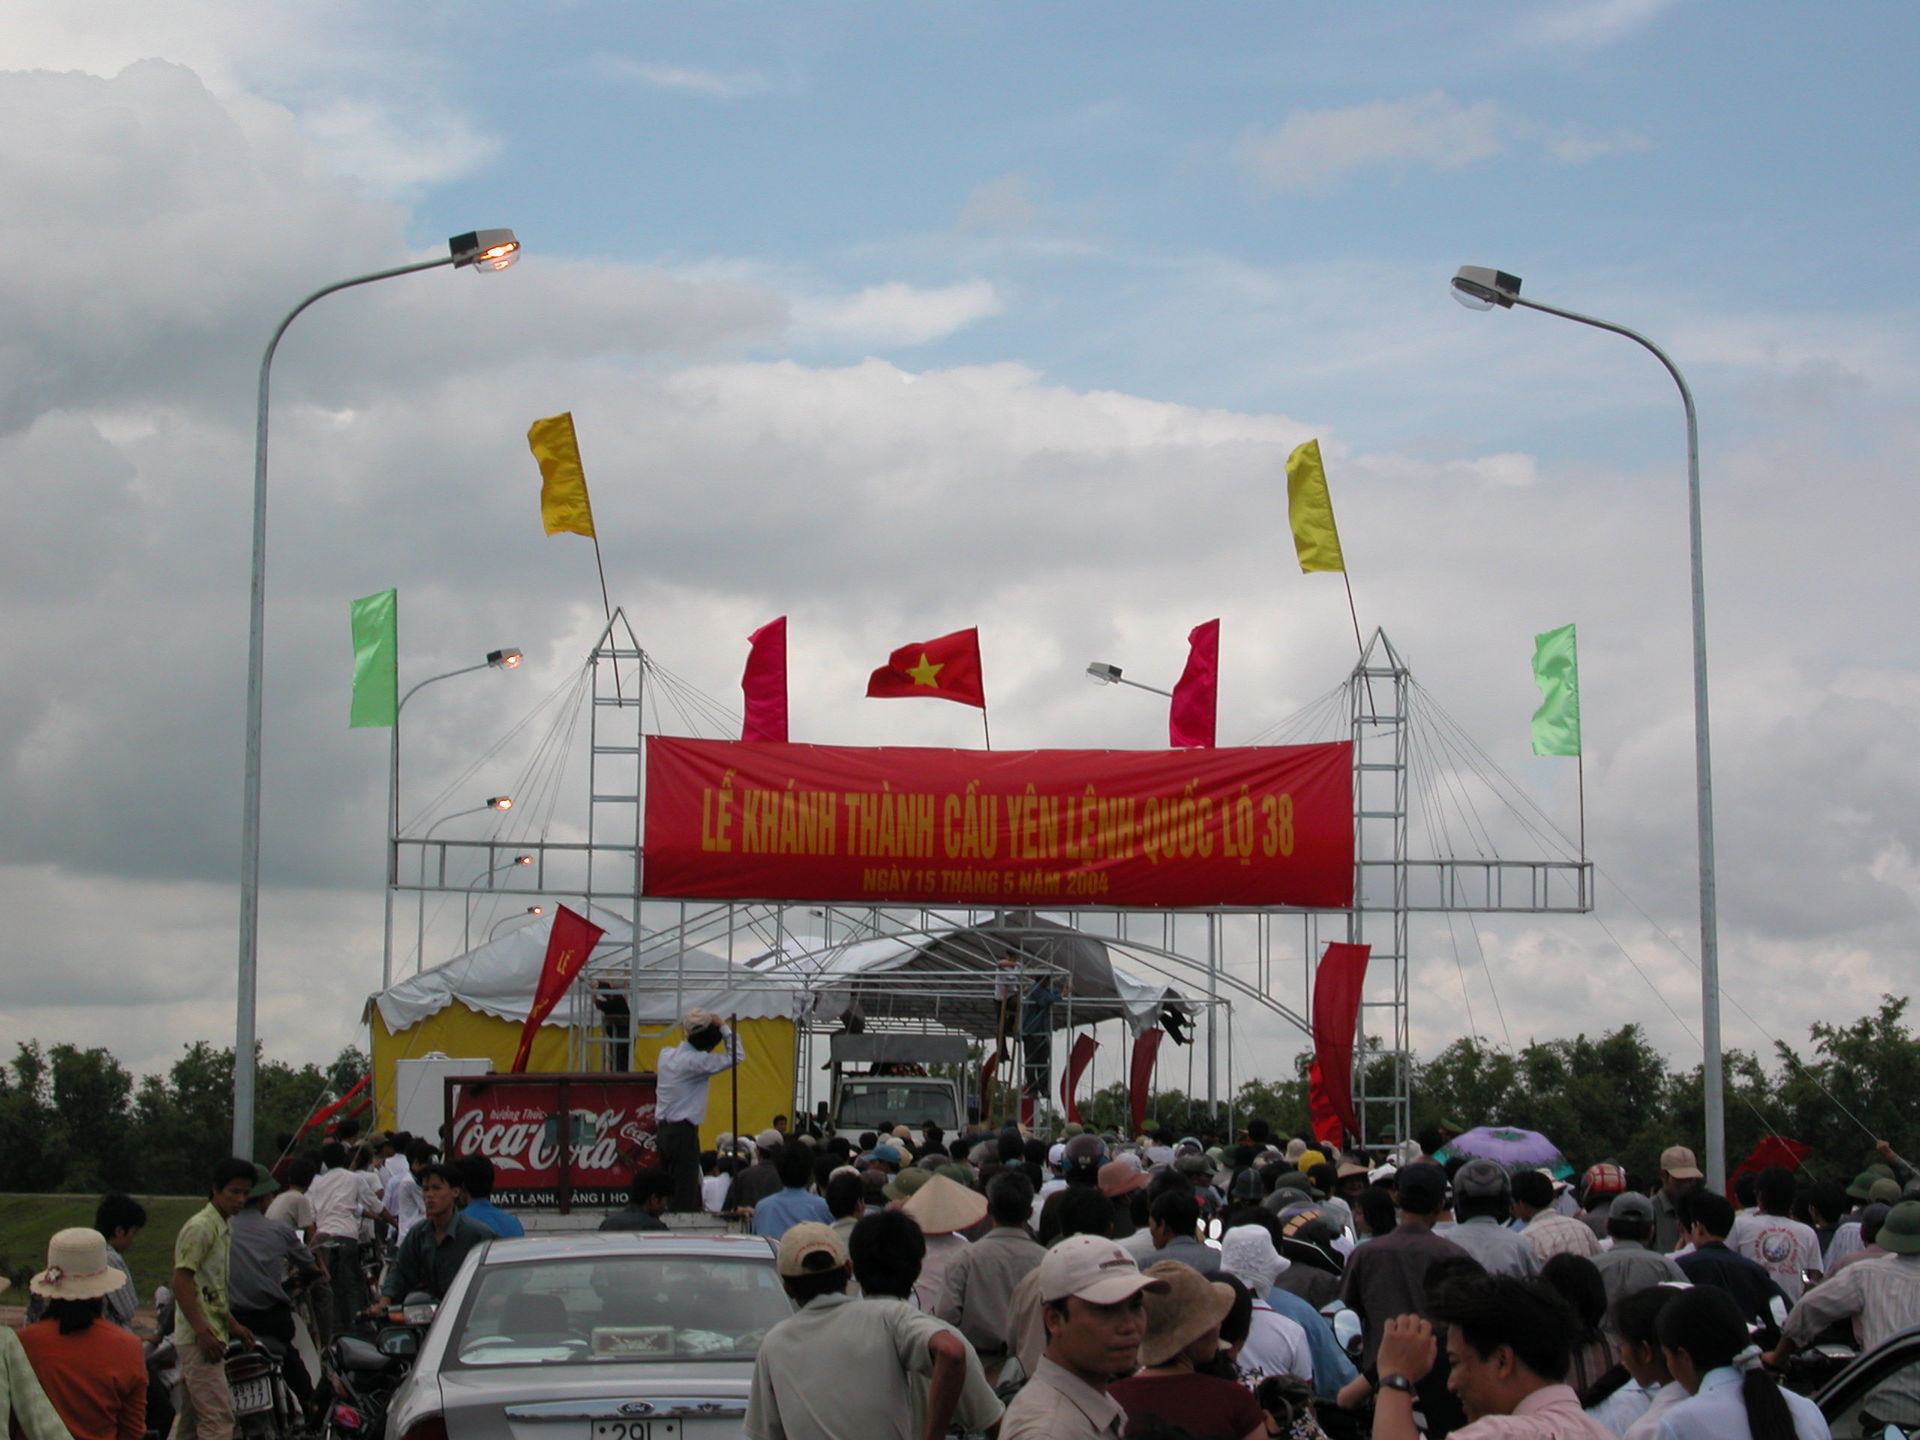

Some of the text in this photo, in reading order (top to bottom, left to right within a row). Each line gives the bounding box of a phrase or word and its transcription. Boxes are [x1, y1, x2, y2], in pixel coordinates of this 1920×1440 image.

[701, 768, 737, 852] LỄ
[741, 778, 836, 856] KHÁNH
[844, 779, 935, 858] THÀNH
[943, 778, 998, 860] CẦU
[1006, 782, 1059, 860] YÊN
[1222, 784, 1254, 866] LỘ
[1261, 792, 1295, 857] 38
[862, 864, 1109, 896] NGÀY 15 THÁNG 5 NĂM 2004
[489, 1191, 518, 1206] MÁT
[570, 1189, 599, 1204] ẢNG
